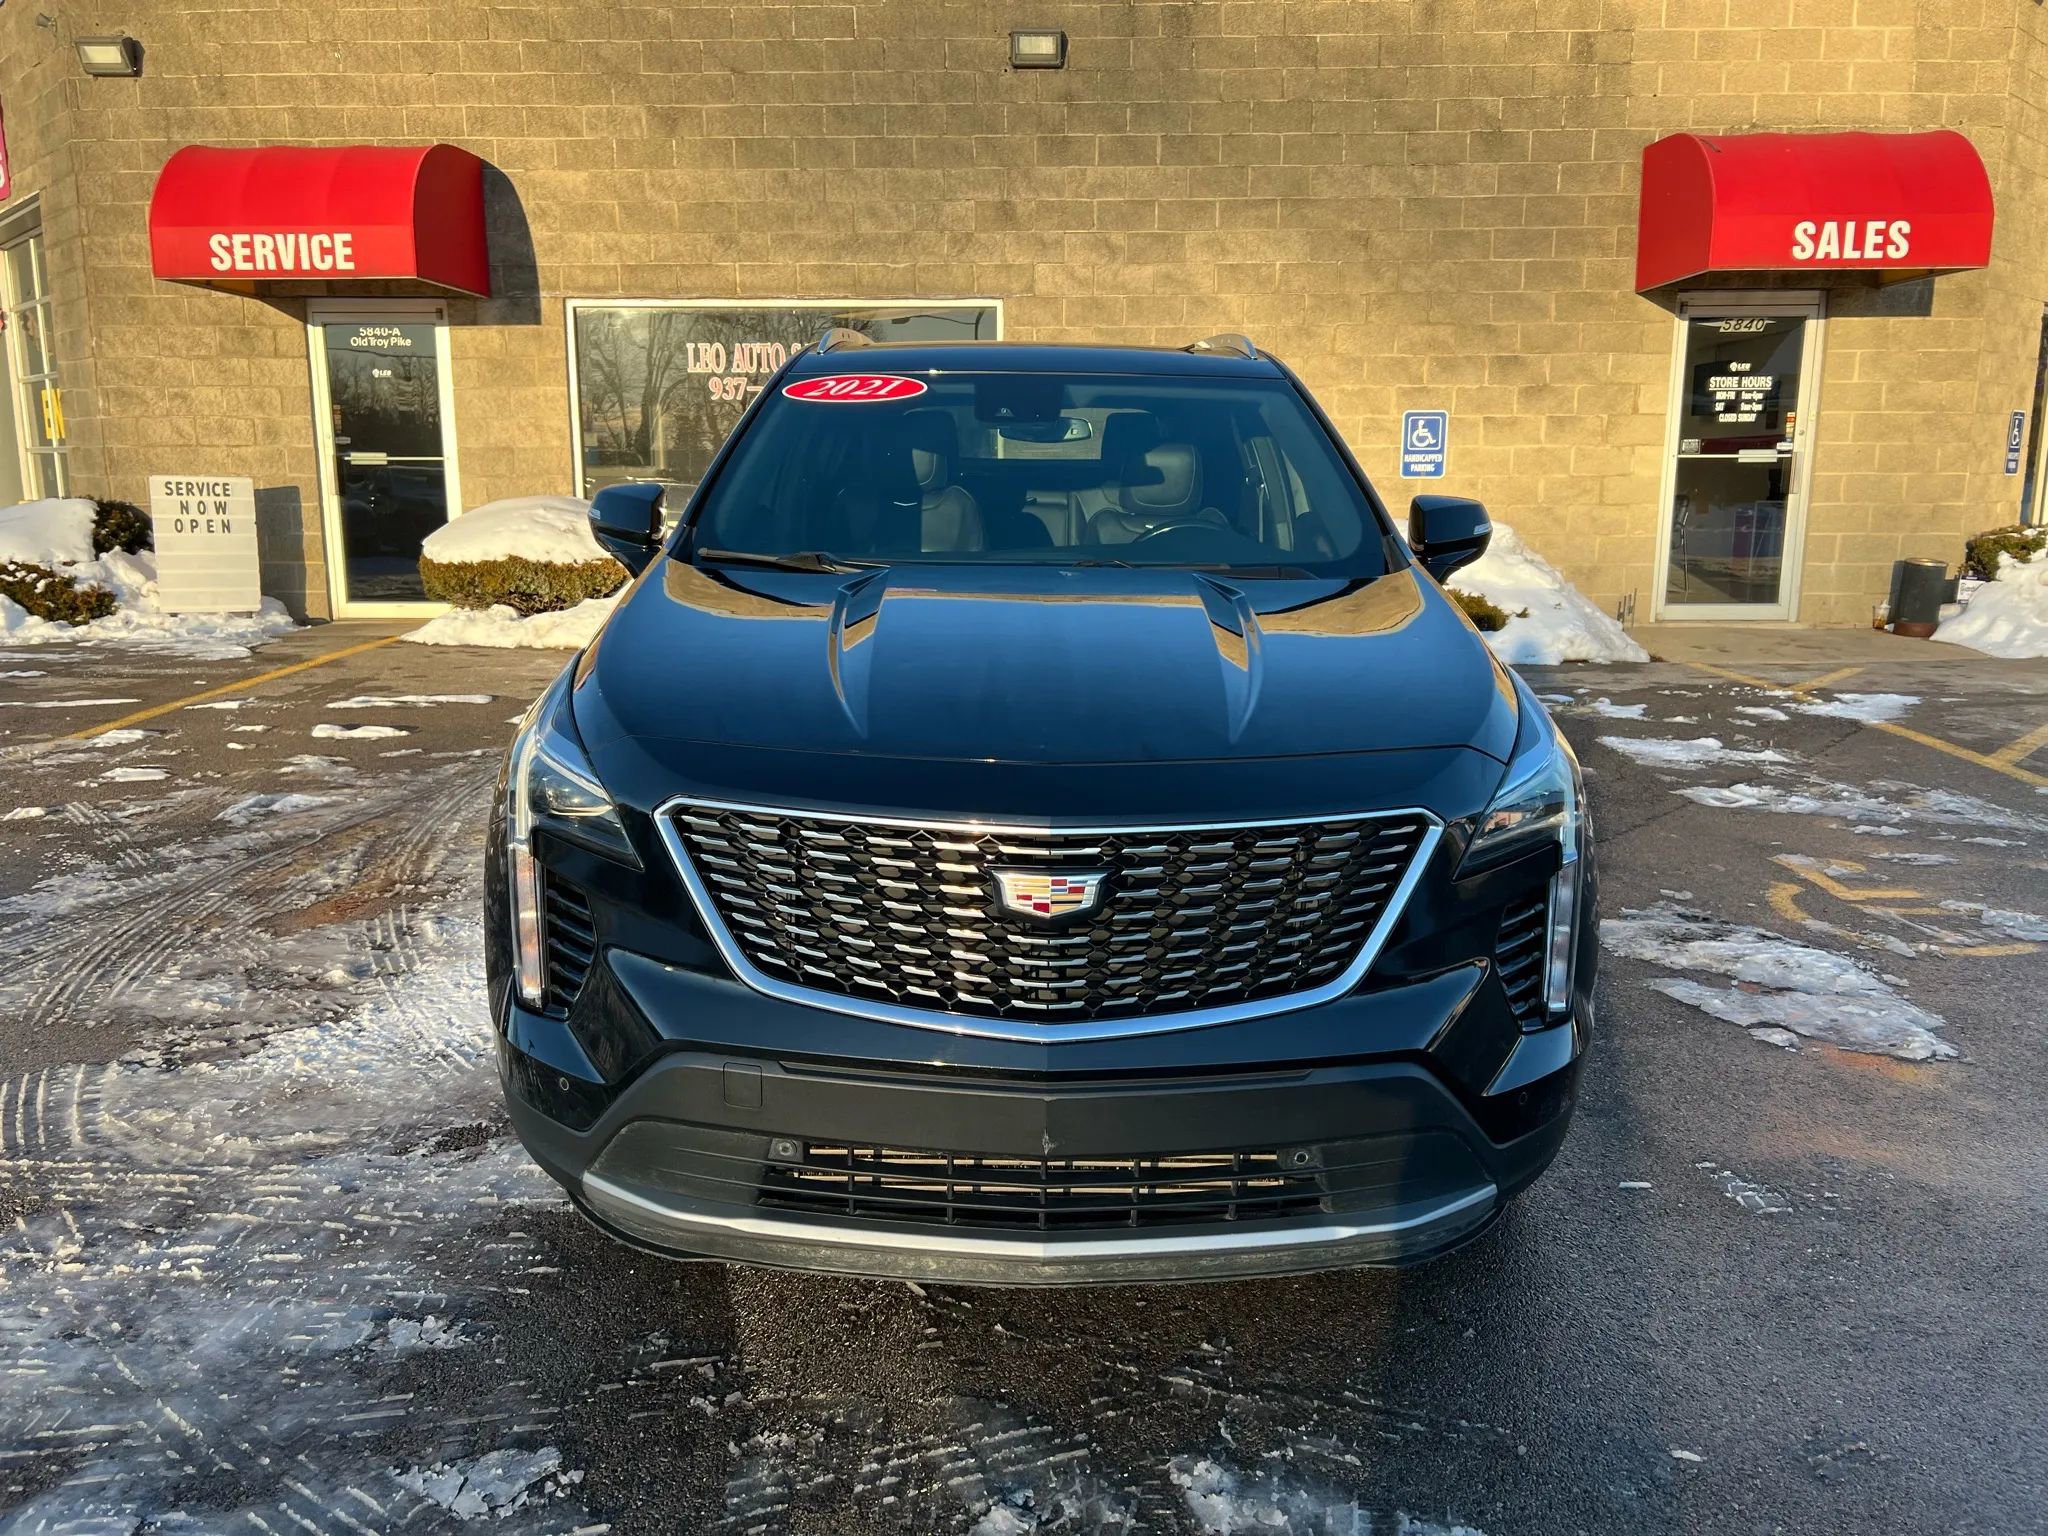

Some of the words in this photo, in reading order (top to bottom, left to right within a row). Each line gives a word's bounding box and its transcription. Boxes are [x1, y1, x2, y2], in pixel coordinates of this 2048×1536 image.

[1792, 220, 1911, 260] SALES
[209, 232, 355, 271] SERVICE
[1722, 318, 1766, 331] 5840
[359, 327, 401, 337] 5840-A
[350, 336, 368, 347] Old
[368, 336, 389, 348] Troy
[391, 336, 412, 347] Pike
[686, 342, 726, 373] LEO
[731, 342, 787, 373] AUTO
[803, 379, 904, 398] 2021
[1709, 376, 1739, 388] STORE
[1741, 376, 1773, 388] HOURS
[1715, 402, 1725, 411] SAT
[1718, 413, 1738, 422] CLOSED
[1738, 413, 1757, 422] SUNDAY
[1404, 454, 1443, 462] HANDICAPPED
[1411, 463, 1436, 472] PARKING
[164, 481, 231, 497] SERVICE
[179, 500, 228, 515] NOW
[174, 518, 232, 534] OPEN
